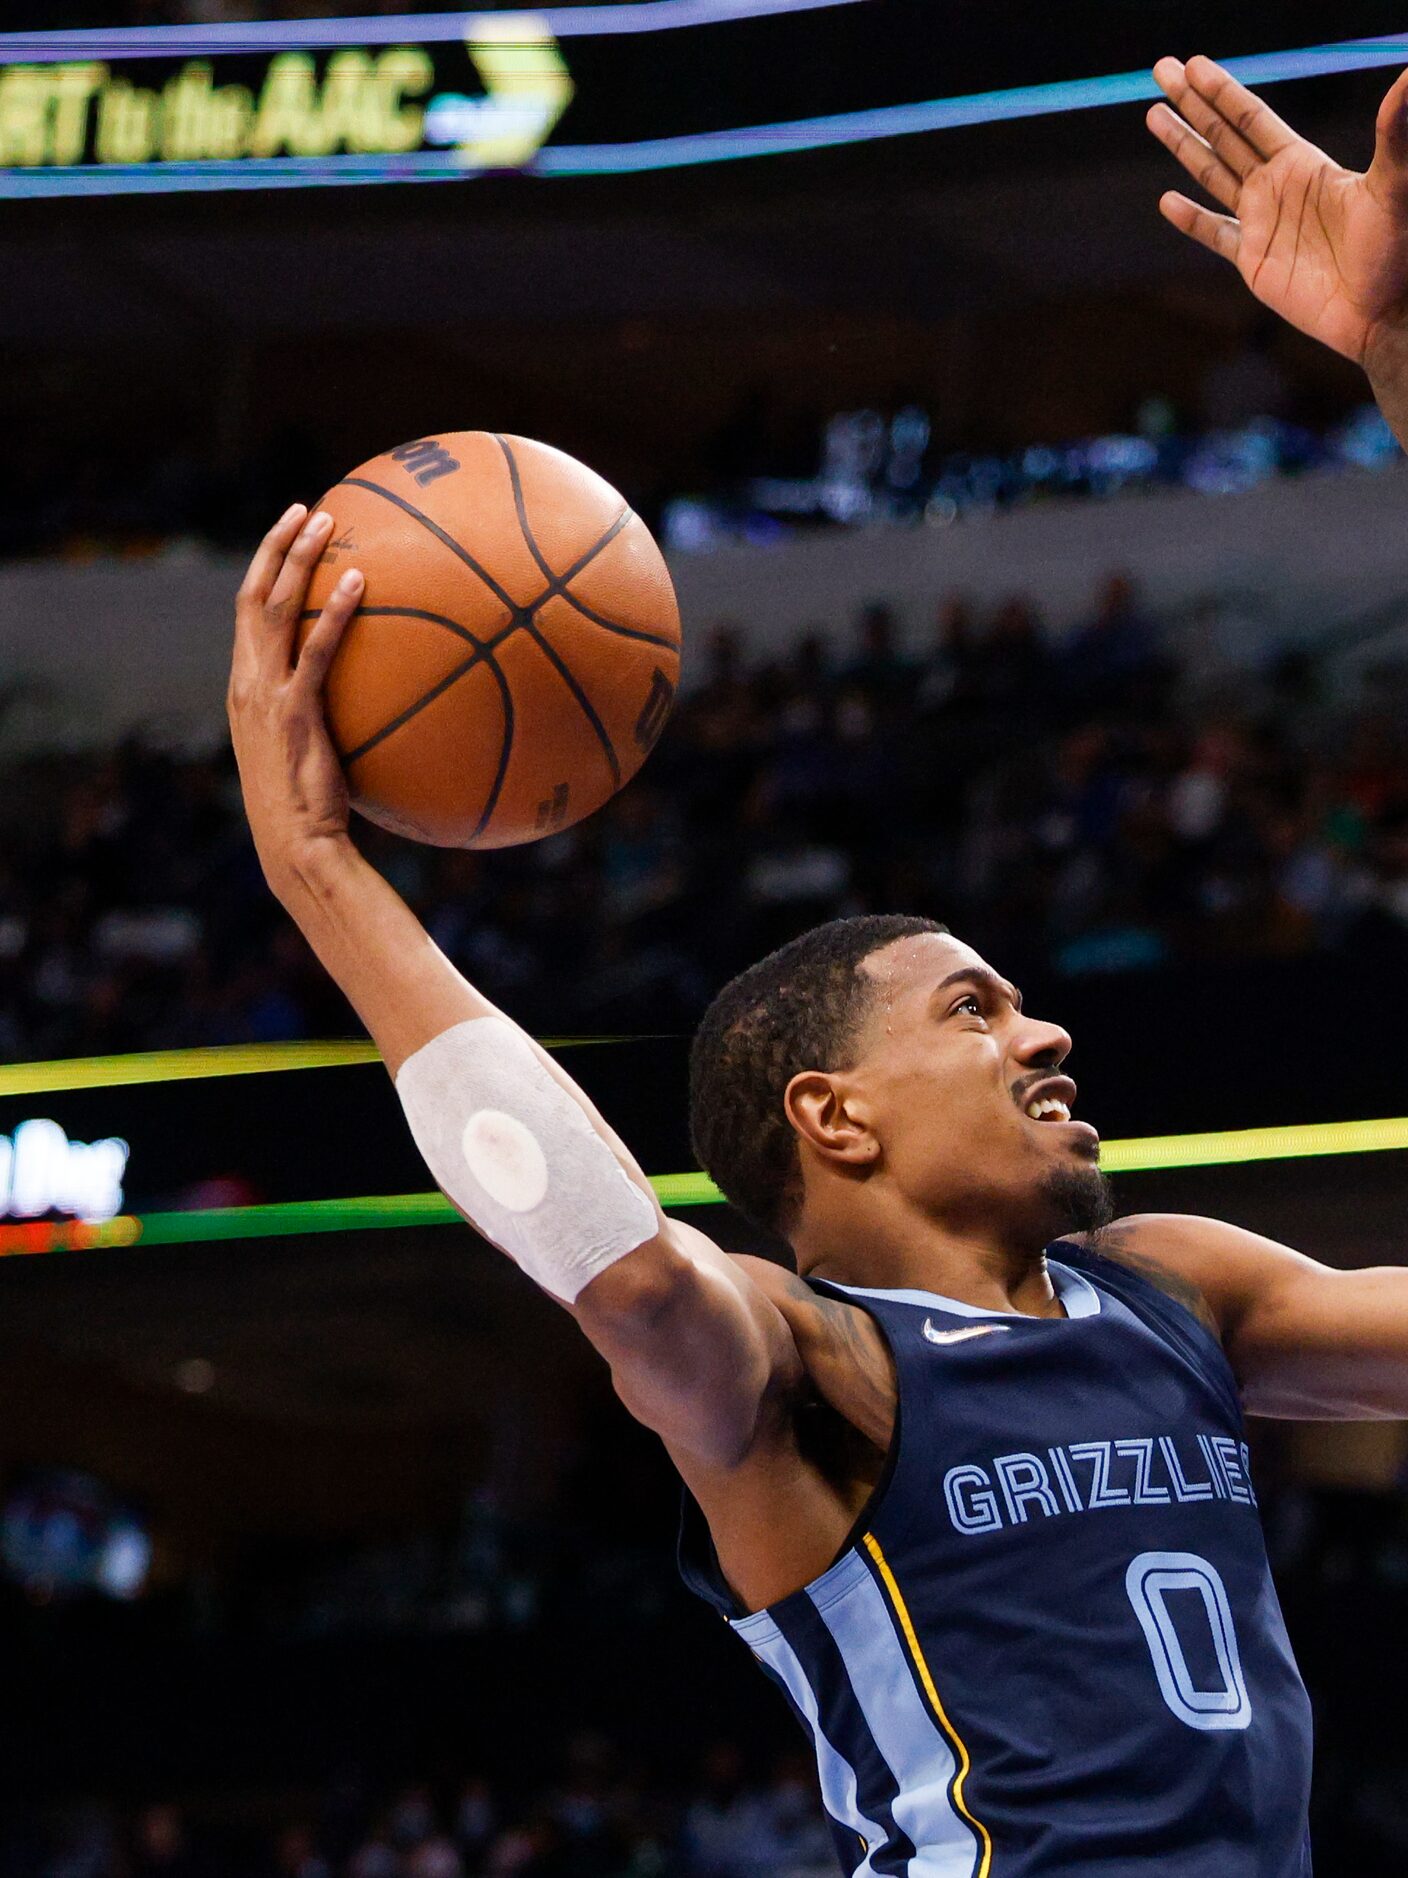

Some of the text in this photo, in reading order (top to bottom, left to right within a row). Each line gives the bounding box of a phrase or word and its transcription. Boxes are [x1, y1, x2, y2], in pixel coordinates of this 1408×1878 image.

[95, 76, 159, 162] to
[158, 60, 256, 160] the
[252, 48, 434, 157] AAC
[384, 440, 460, 488] on
[1125, 1551, 1252, 1731] 0
